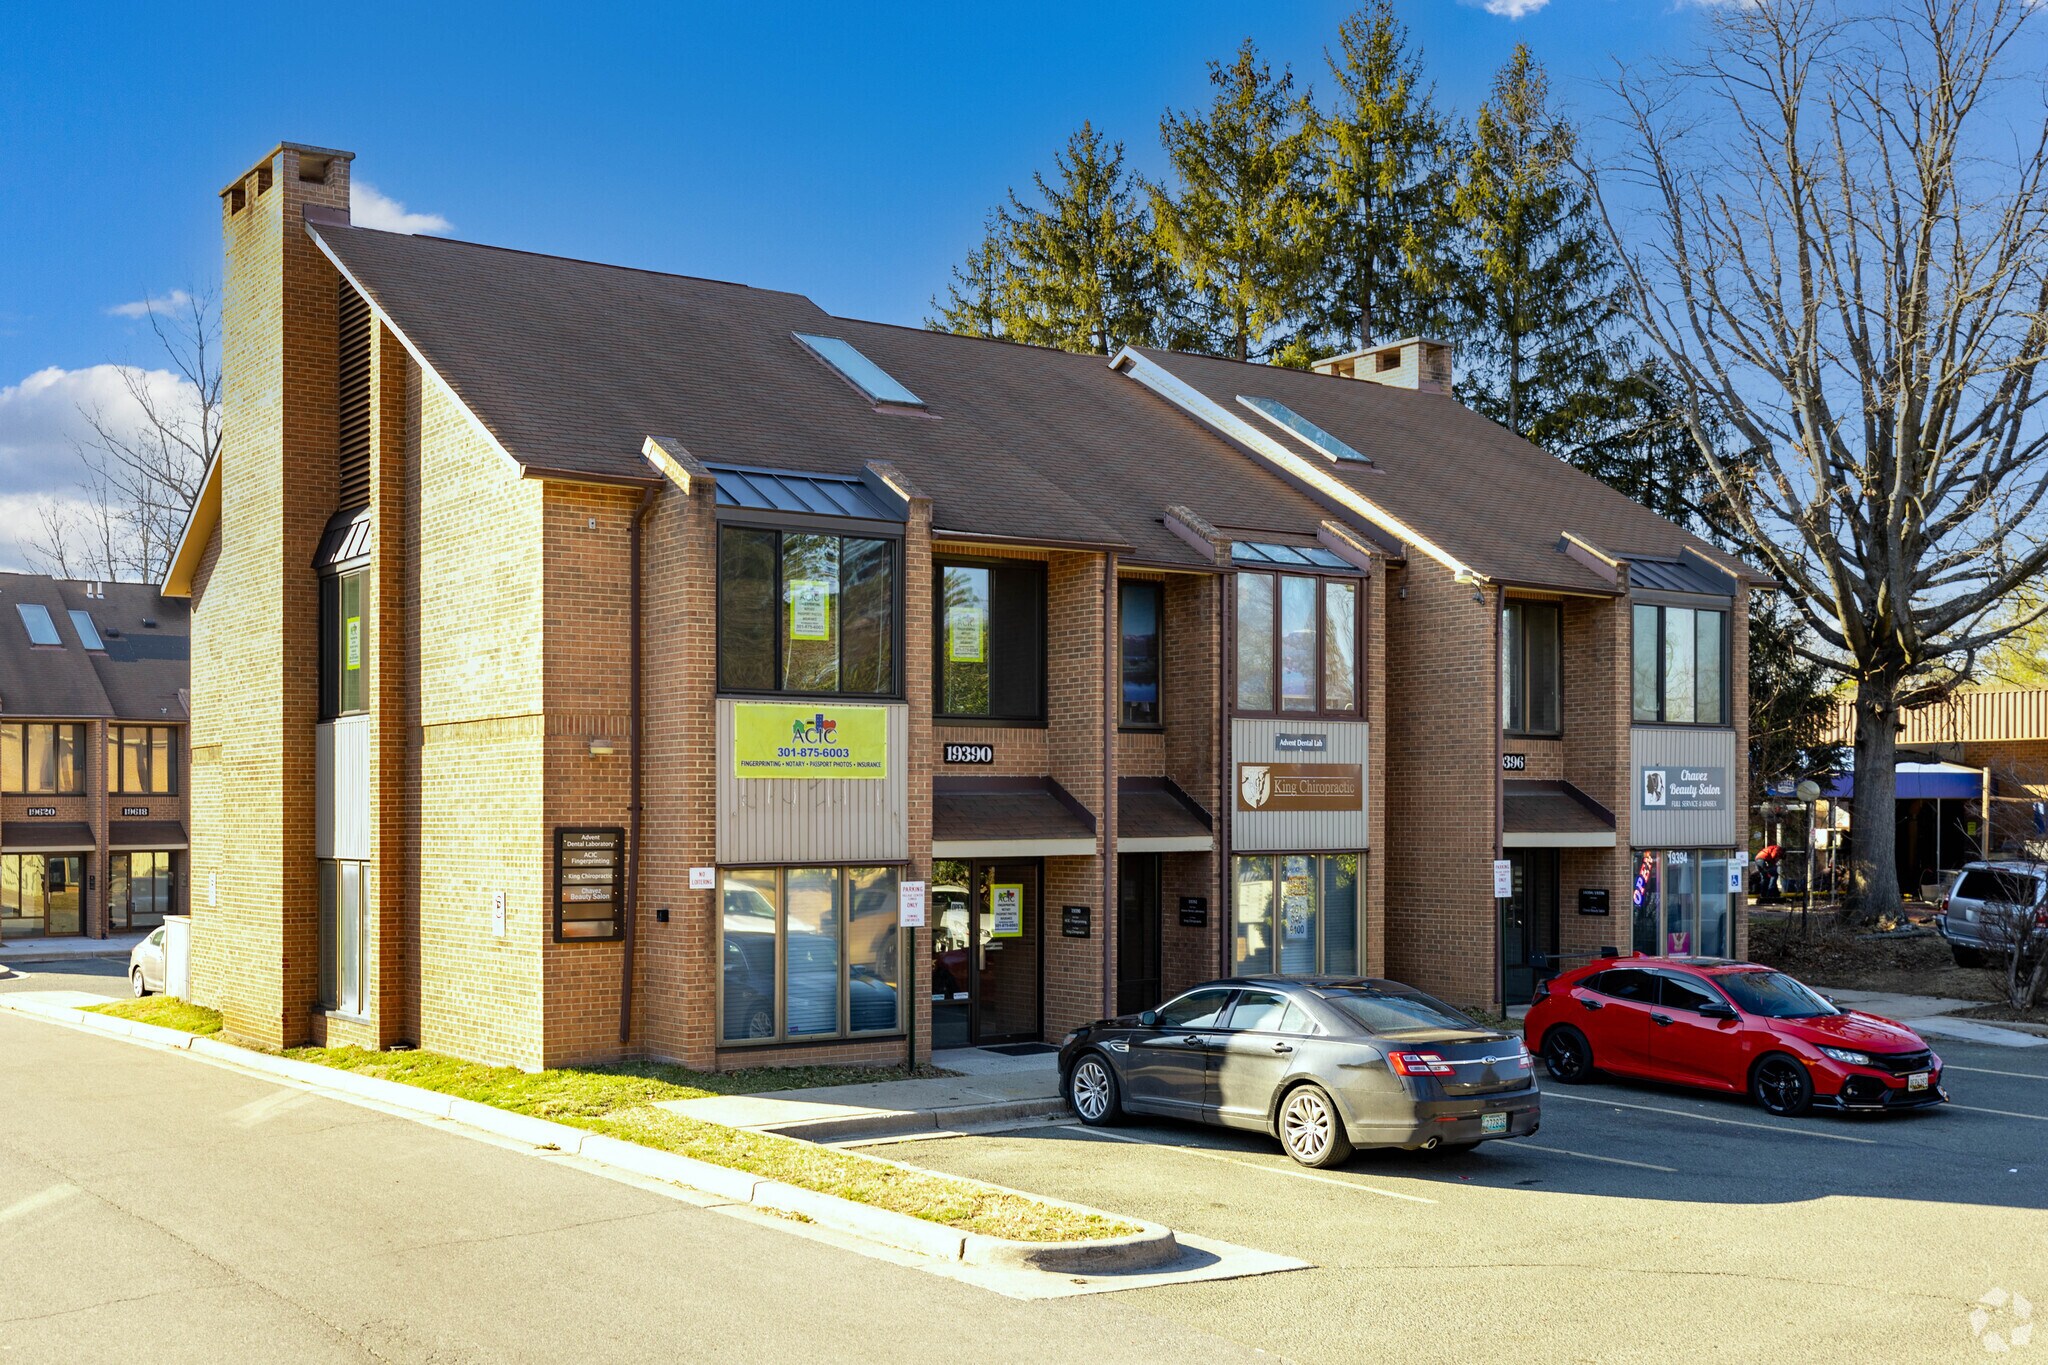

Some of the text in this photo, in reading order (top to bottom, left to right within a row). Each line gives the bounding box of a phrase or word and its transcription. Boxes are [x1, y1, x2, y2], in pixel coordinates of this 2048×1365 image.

[792, 728, 837, 745] ACIC
[1279, 738, 1323, 747] Advent Dental Lab
[777, 747, 849, 758] 301-875-6003
[946, 745, 992, 762] 19390
[1503, 755, 1524, 769] 396
[1680, 769, 1708, 781] Chavez
[1274, 779, 1355, 796] King Chiropractic
[1669, 783, 1720, 798] Beauty Salon
[28, 808, 55, 816] 19620
[124, 808, 148, 816] 19618
[1667, 851, 1688, 864] 19394
